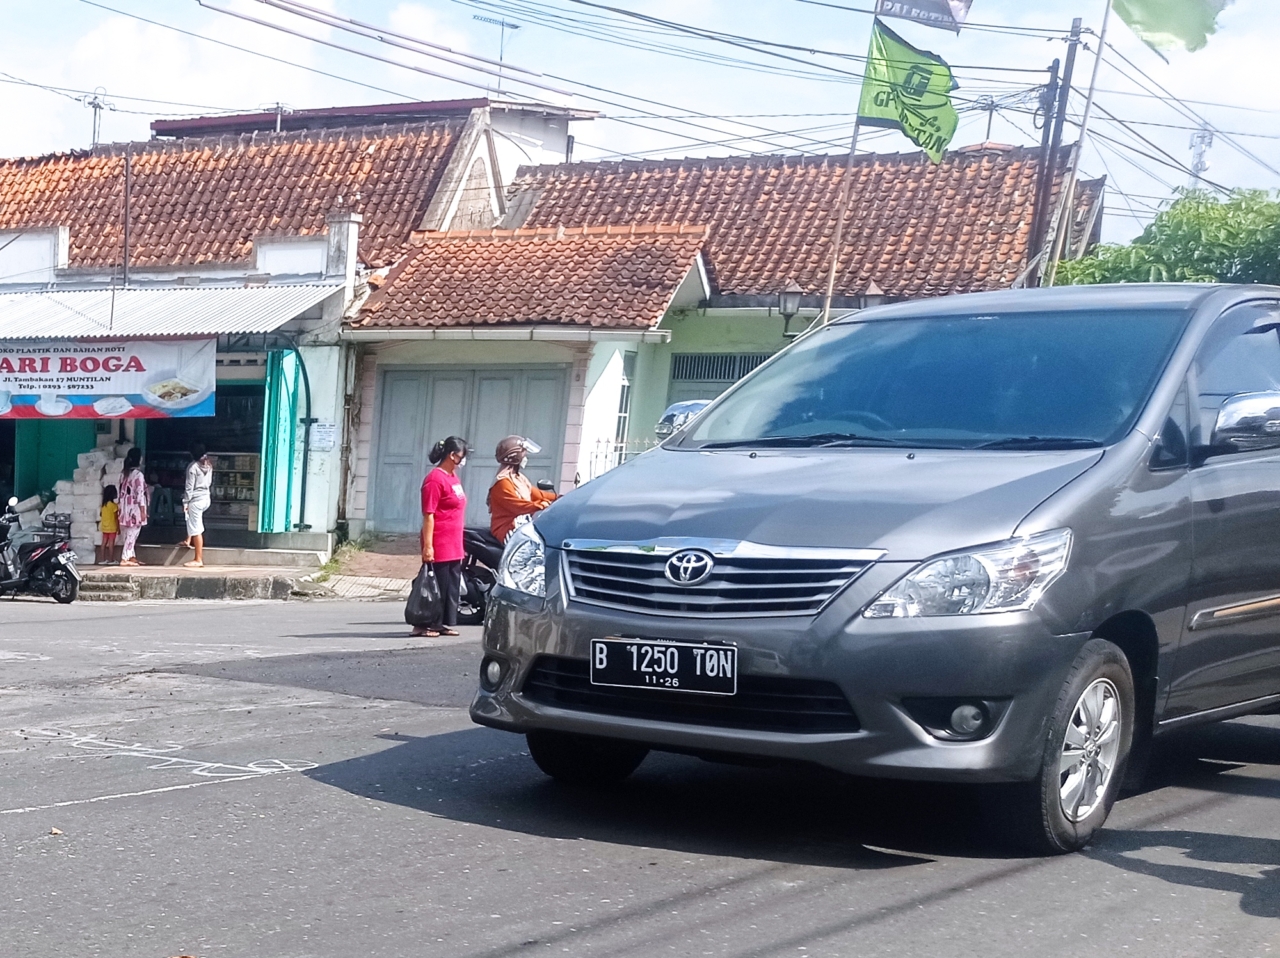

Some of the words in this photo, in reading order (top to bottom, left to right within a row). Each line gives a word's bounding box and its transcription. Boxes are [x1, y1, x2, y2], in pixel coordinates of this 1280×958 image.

[58, 355, 147, 373] BOGA
[595, 643, 608, 669] B
[629, 645, 679, 674] 1250
